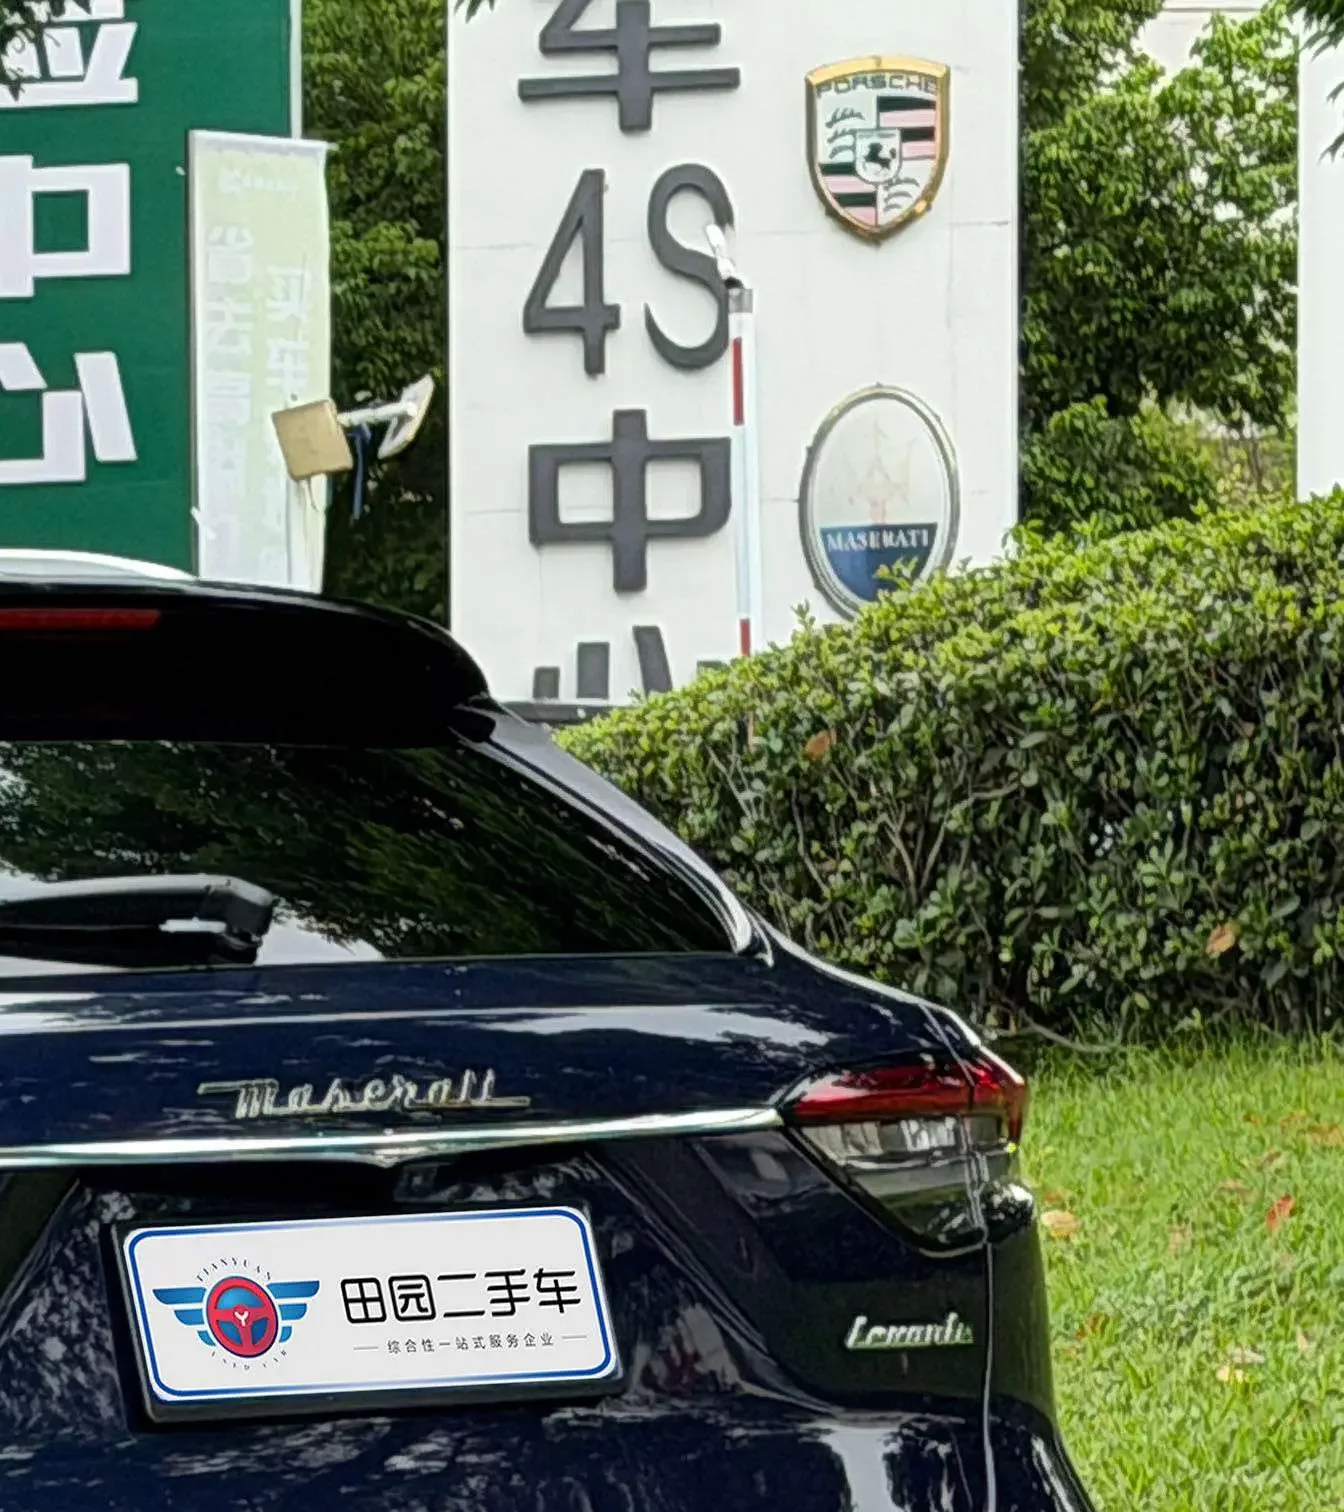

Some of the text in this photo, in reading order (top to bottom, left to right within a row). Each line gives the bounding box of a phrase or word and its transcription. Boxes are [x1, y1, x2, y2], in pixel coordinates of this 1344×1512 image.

[815, 74, 939, 99] PORSCHE
[825, 528, 930, 552] MASERATI
[340, 1267, 581, 1325] 田园二手车
[386, 1331, 555, 1354] 综合性一站式服务企业
